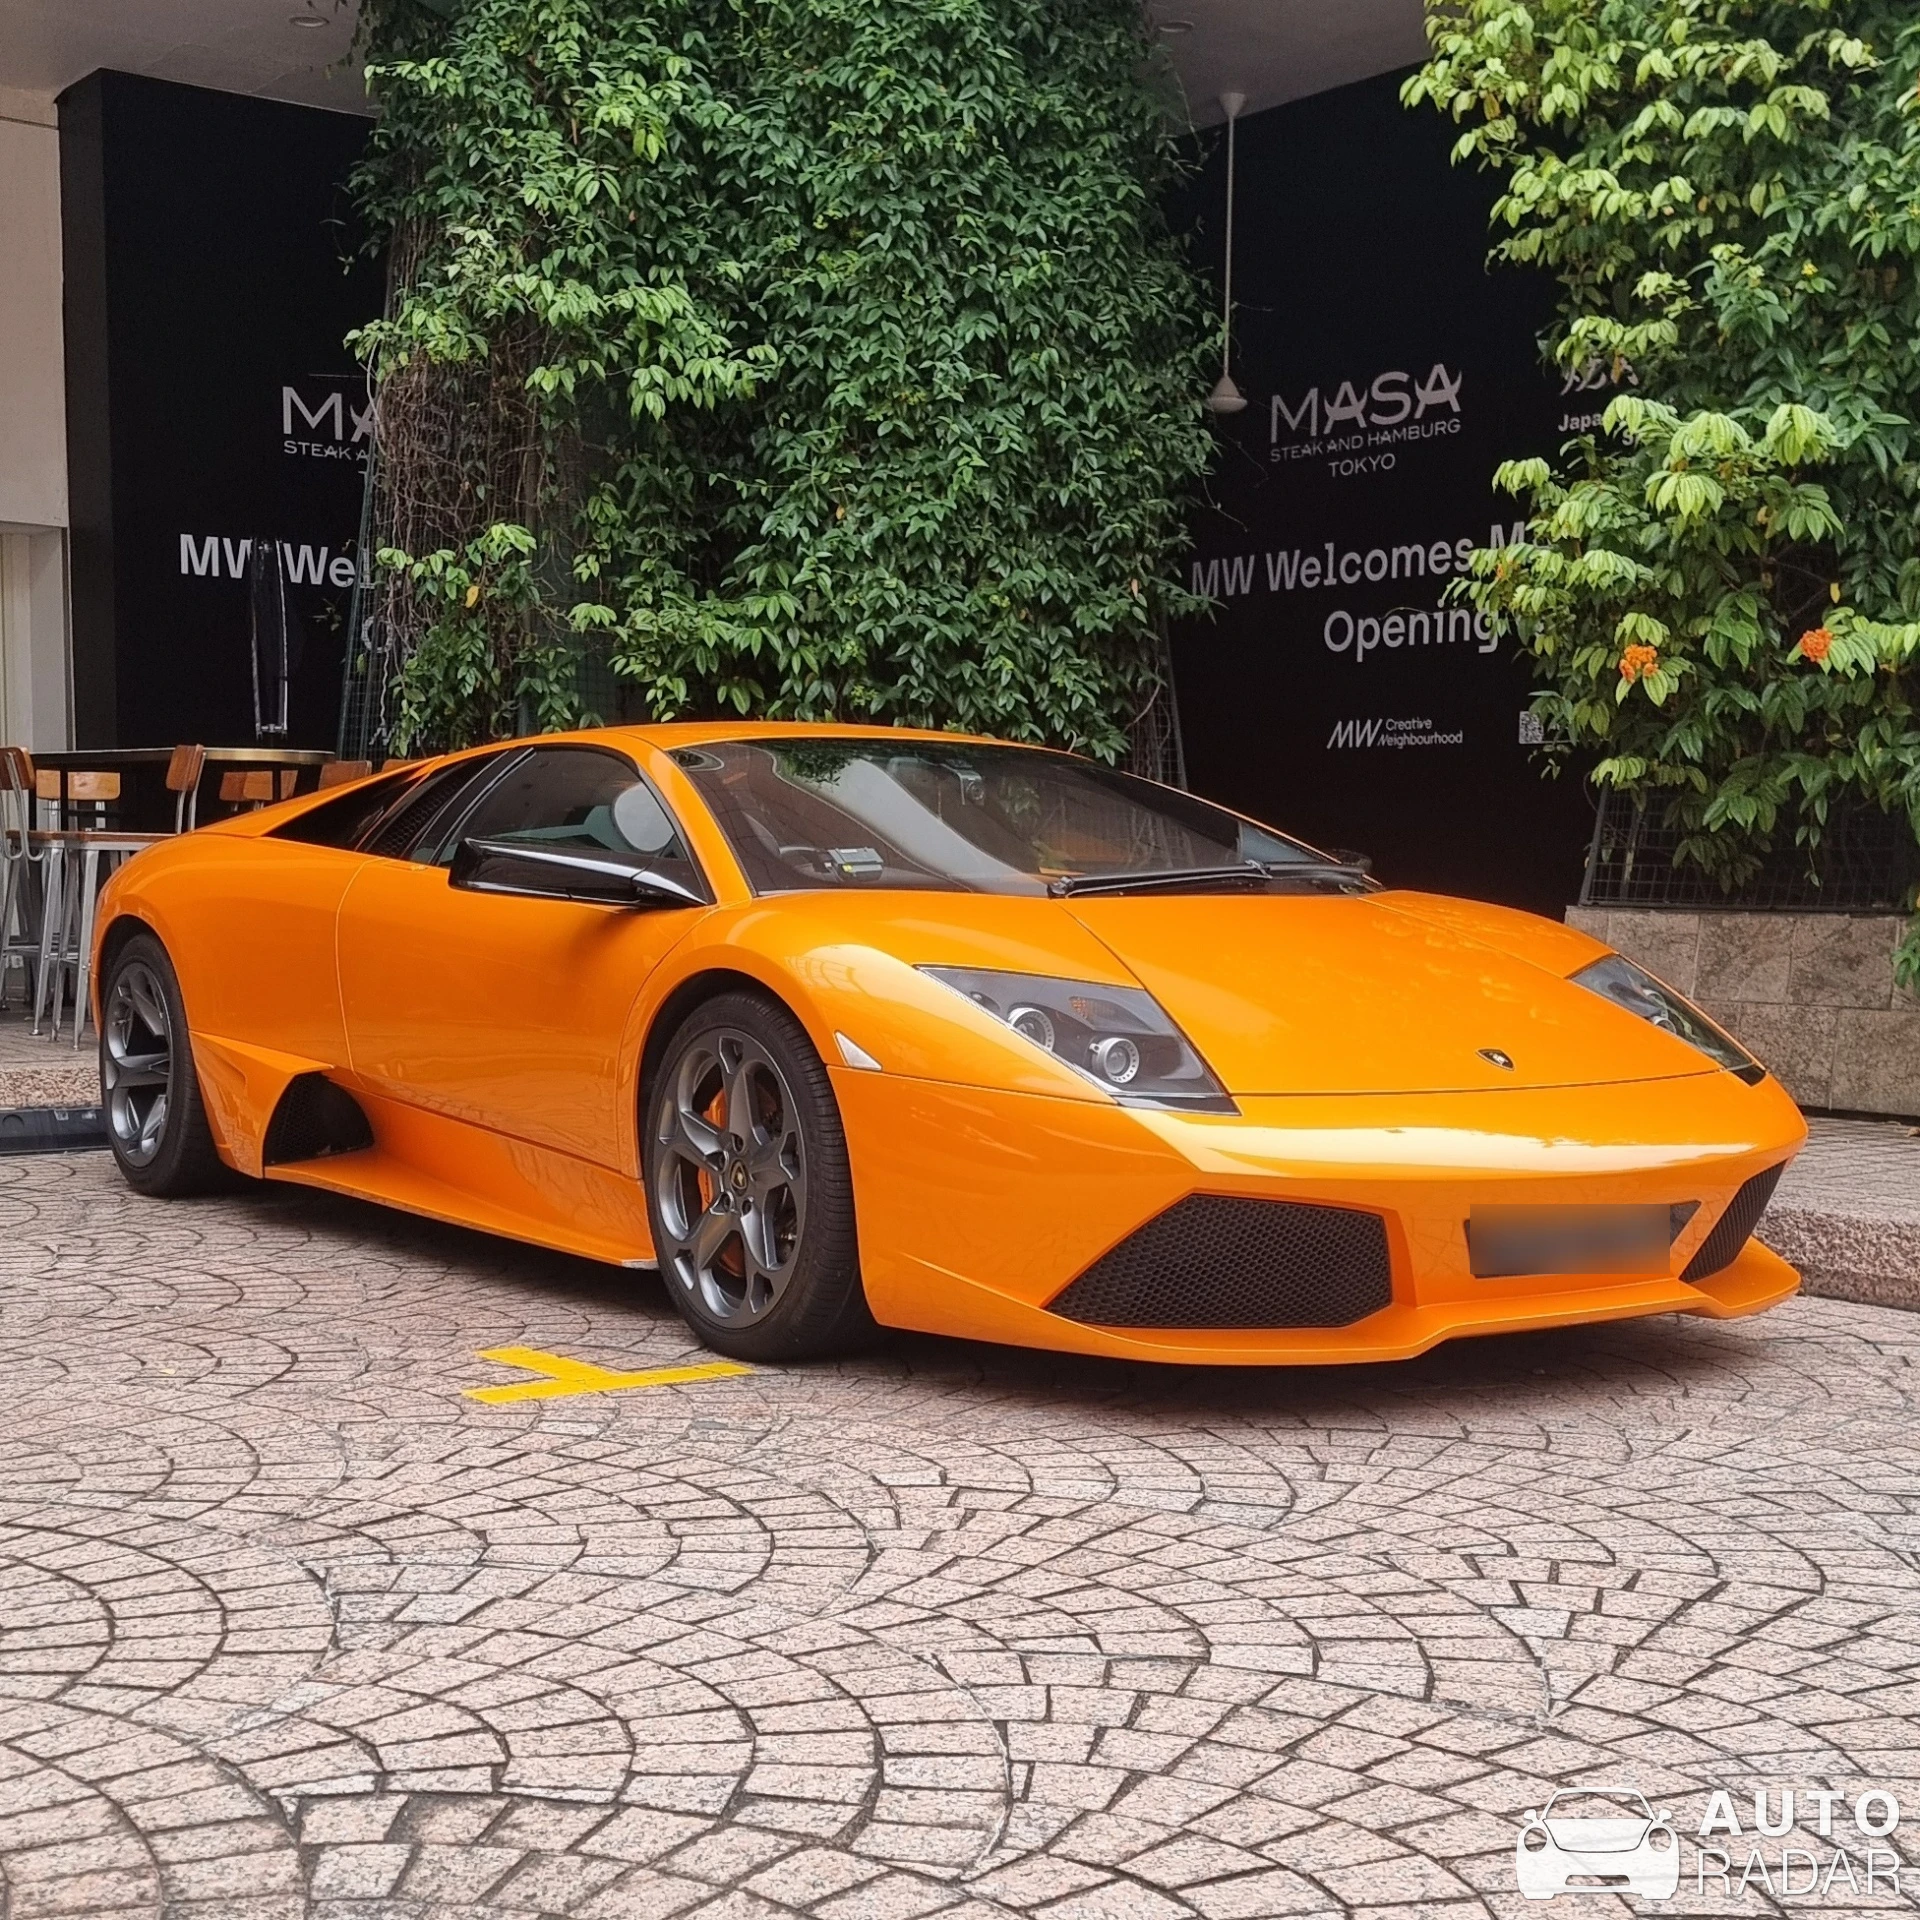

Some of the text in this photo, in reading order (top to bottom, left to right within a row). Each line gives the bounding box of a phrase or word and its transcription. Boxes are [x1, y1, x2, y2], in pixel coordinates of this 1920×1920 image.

[1271, 364, 1462, 443] MASA
[284, 440, 352, 461] STEAK
[1270, 419, 1461, 463] STEAK AND HAMBURG
[1328, 453, 1397, 478] TOKYO
[1191, 555, 1255, 599] MW
[1266, 540, 1475, 592] Welcomes
[1324, 598, 1499, 663] Opening
[1326, 717, 1463, 750] MW Creative Neighbourhood
